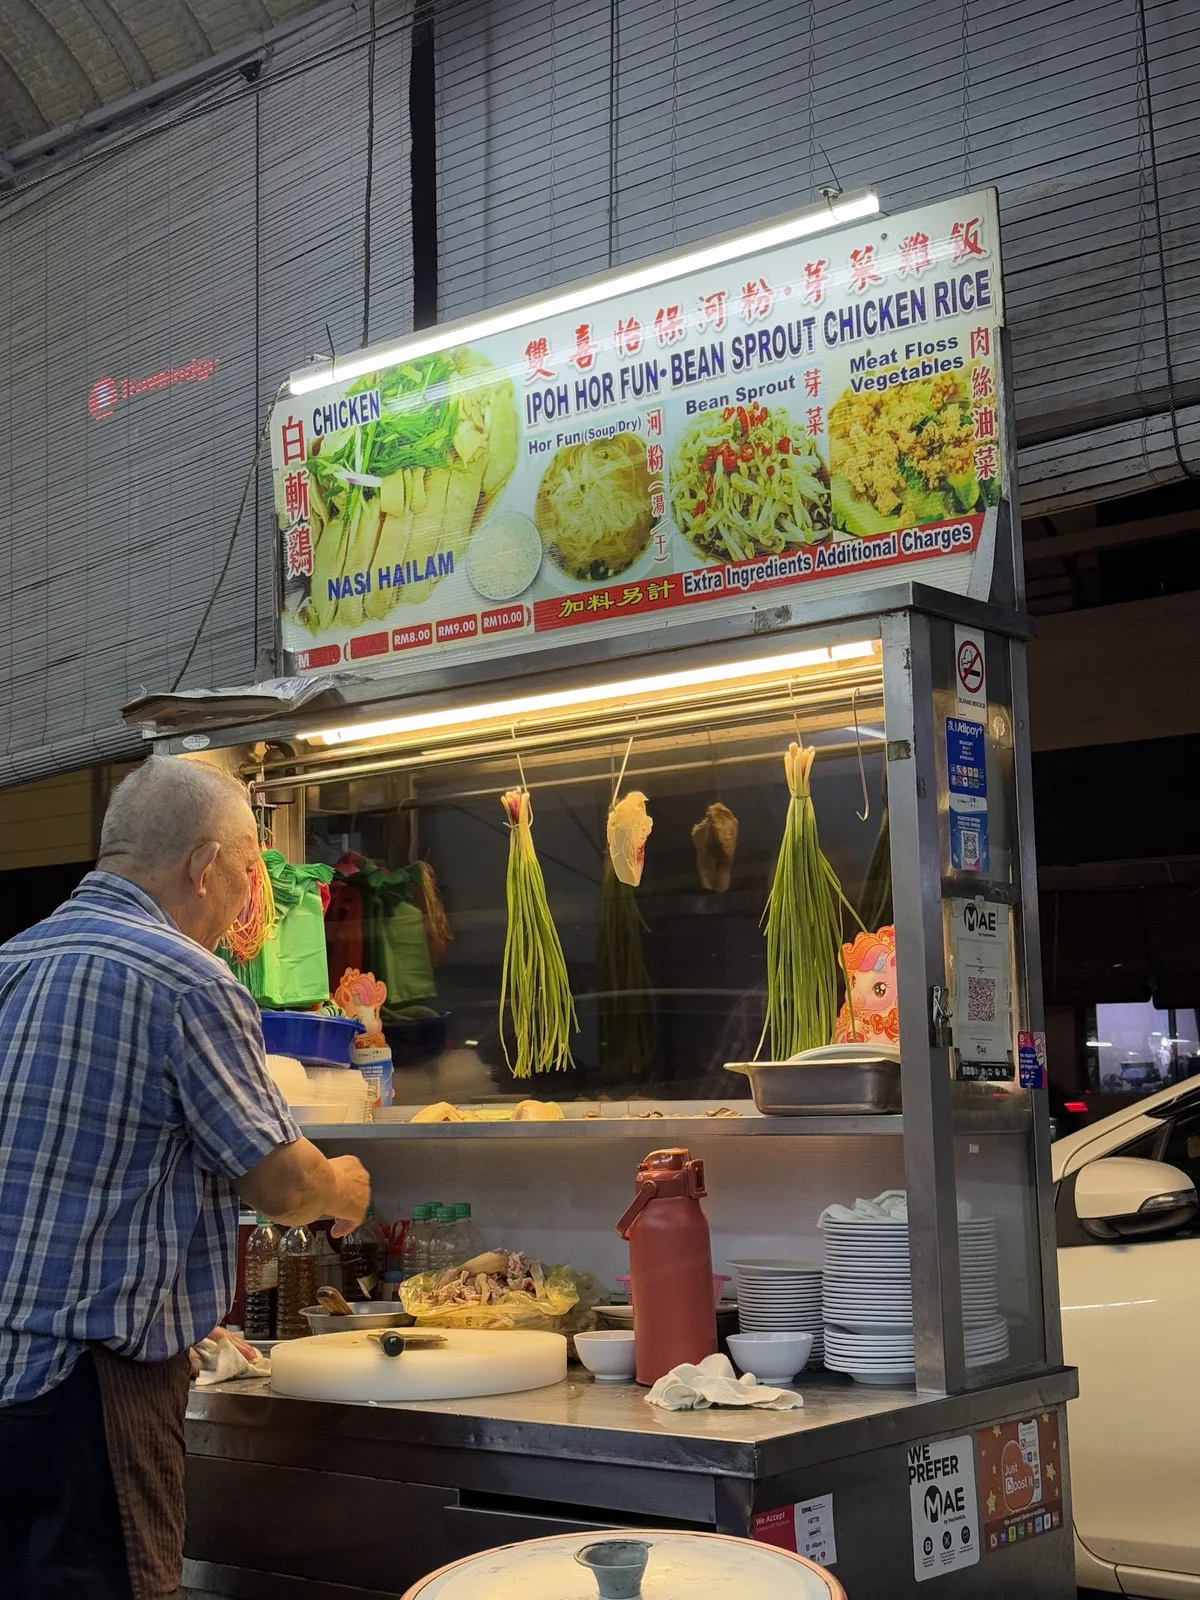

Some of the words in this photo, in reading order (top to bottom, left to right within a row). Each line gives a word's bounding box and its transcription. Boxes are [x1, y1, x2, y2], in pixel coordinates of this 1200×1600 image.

[526, 384, 569, 424] IPOH
[575, 372, 615, 413] HOR
[671, 341, 726, 386] BEAN
[732, 316, 817, 370] SPROUT
[824, 287, 926, 346] CHICKEN
[934, 269, 992, 315] RICE
[850, 349, 898, 374] Meat
[905, 336, 959, 359] Floss
[850, 355, 964, 393] Vegetables
[312, 391, 380, 436] CHICKEN
[686, 394, 729, 415] Bean
[735, 374, 796, 403] Sprout
[803, 367, 825, 438] 芽菜
[969, 326, 997, 480] 肉絲油菜
[529, 439, 552, 455] Hor
[556, 432, 580, 447] Fun
[584, 416, 641, 443] (Soup/Dry)
[327, 571, 371, 601] NASI
[378, 551, 455, 590] HAILAM
[684, 573, 722, 594] Extra
[727, 553, 812, 587] Ingredients
[817, 535, 897, 568] Additional
[902, 524, 972, 550] Charges
[558, 580, 676, 618] 加料另計
[394, 628, 431, 646] RM8.00
[438, 620, 476, 637] RM9.00
[483, 611, 522, 629] RM10.00
[964, 903, 996, 931] MAE
[908, 1444, 931, 1464] WE
[908, 1455, 959, 1485] PREFER
[1005, 1462, 1018, 1475] Just
[755, 1516, 765, 1525] We
[766, 1511, 786, 1524] Accept
[924, 1485, 966, 1523] MAE
